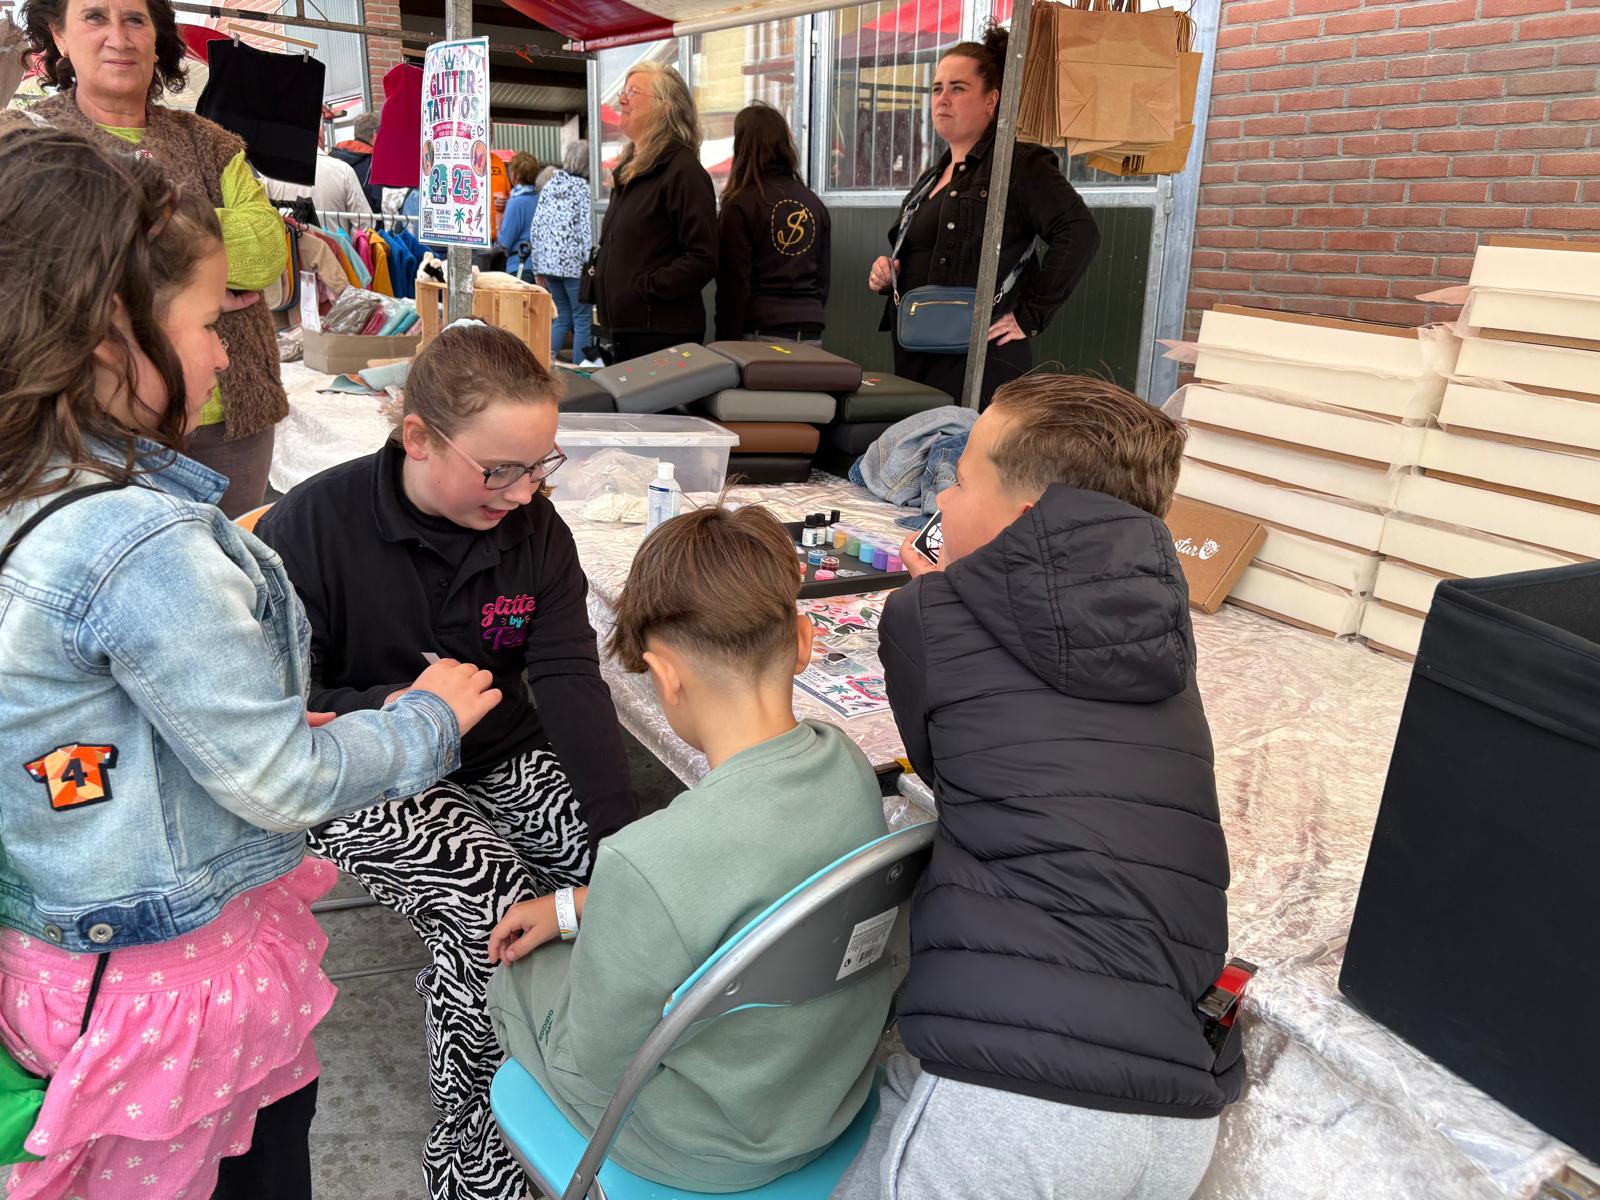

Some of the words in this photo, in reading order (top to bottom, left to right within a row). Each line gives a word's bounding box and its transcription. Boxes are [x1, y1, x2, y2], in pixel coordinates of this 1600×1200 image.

[430, 70, 475, 97] GLITTER
[427, 96, 479, 122] TATTOS
[454, 169, 462, 195] 2
[481, 594, 536, 627] glitte
[509, 615, 524, 628] by
[61, 758, 88, 788] 4
